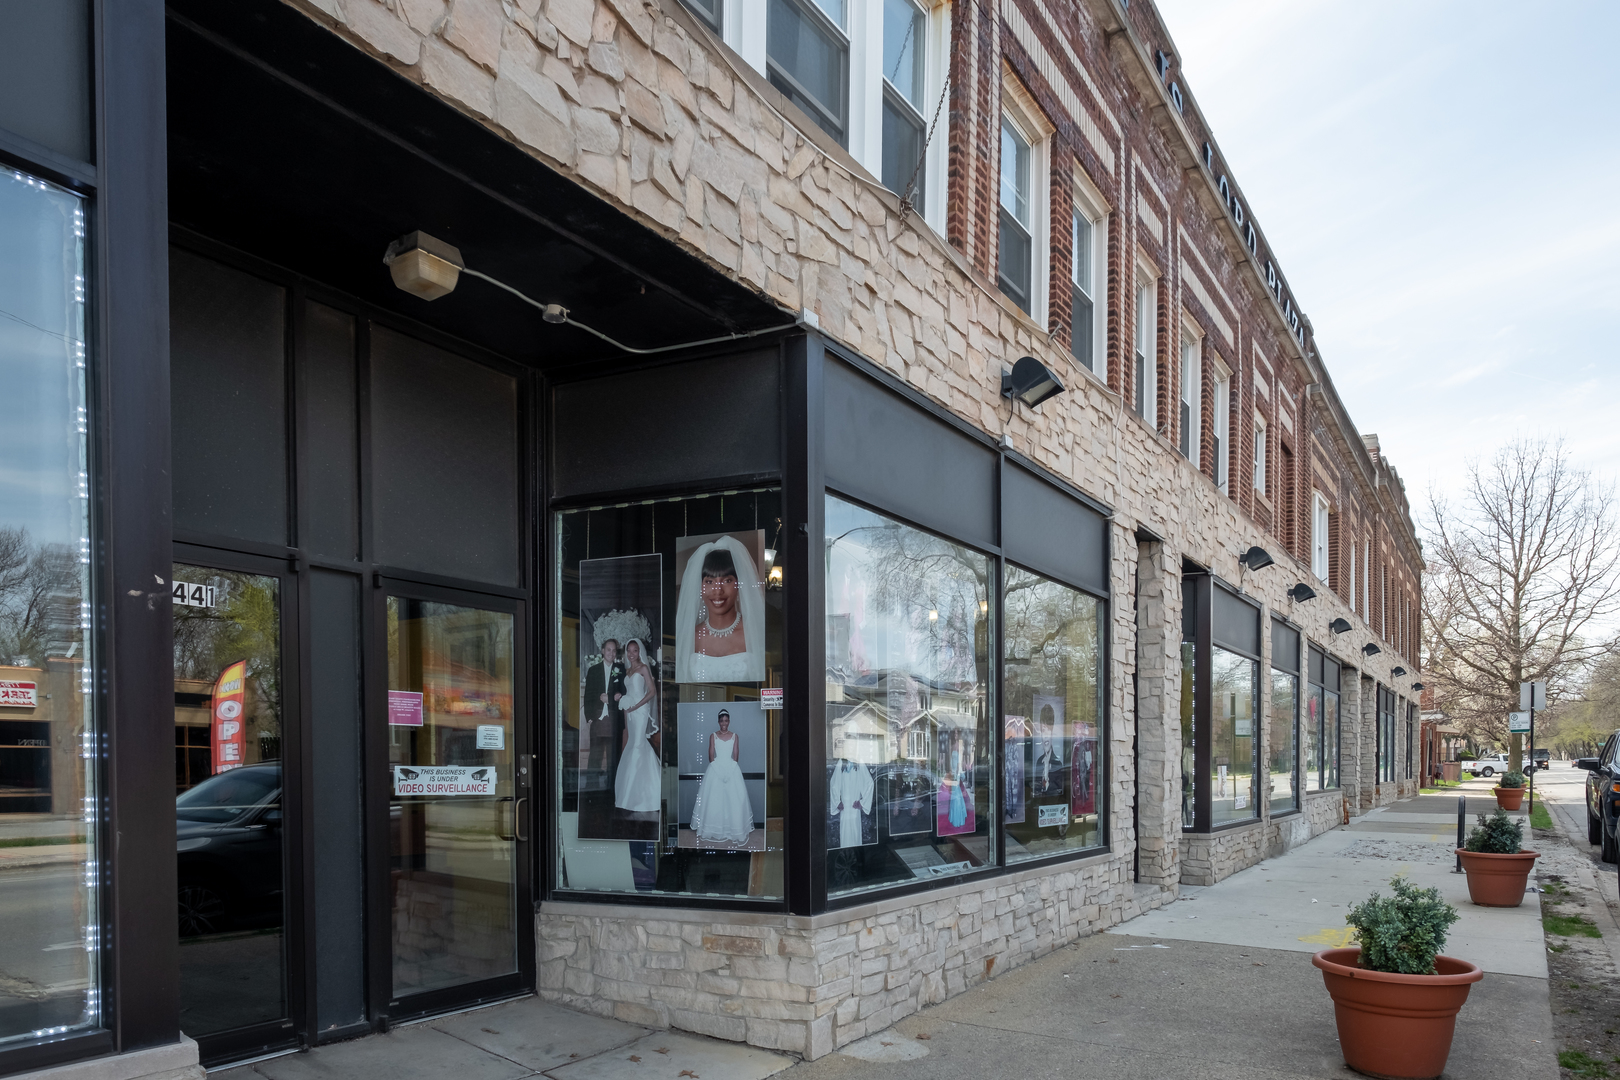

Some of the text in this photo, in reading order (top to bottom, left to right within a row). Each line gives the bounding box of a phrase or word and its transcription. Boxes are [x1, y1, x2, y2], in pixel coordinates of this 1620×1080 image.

[173, 582, 215, 607] 441
[398, 783, 488, 793] VIDEO SURVEILLANCE
